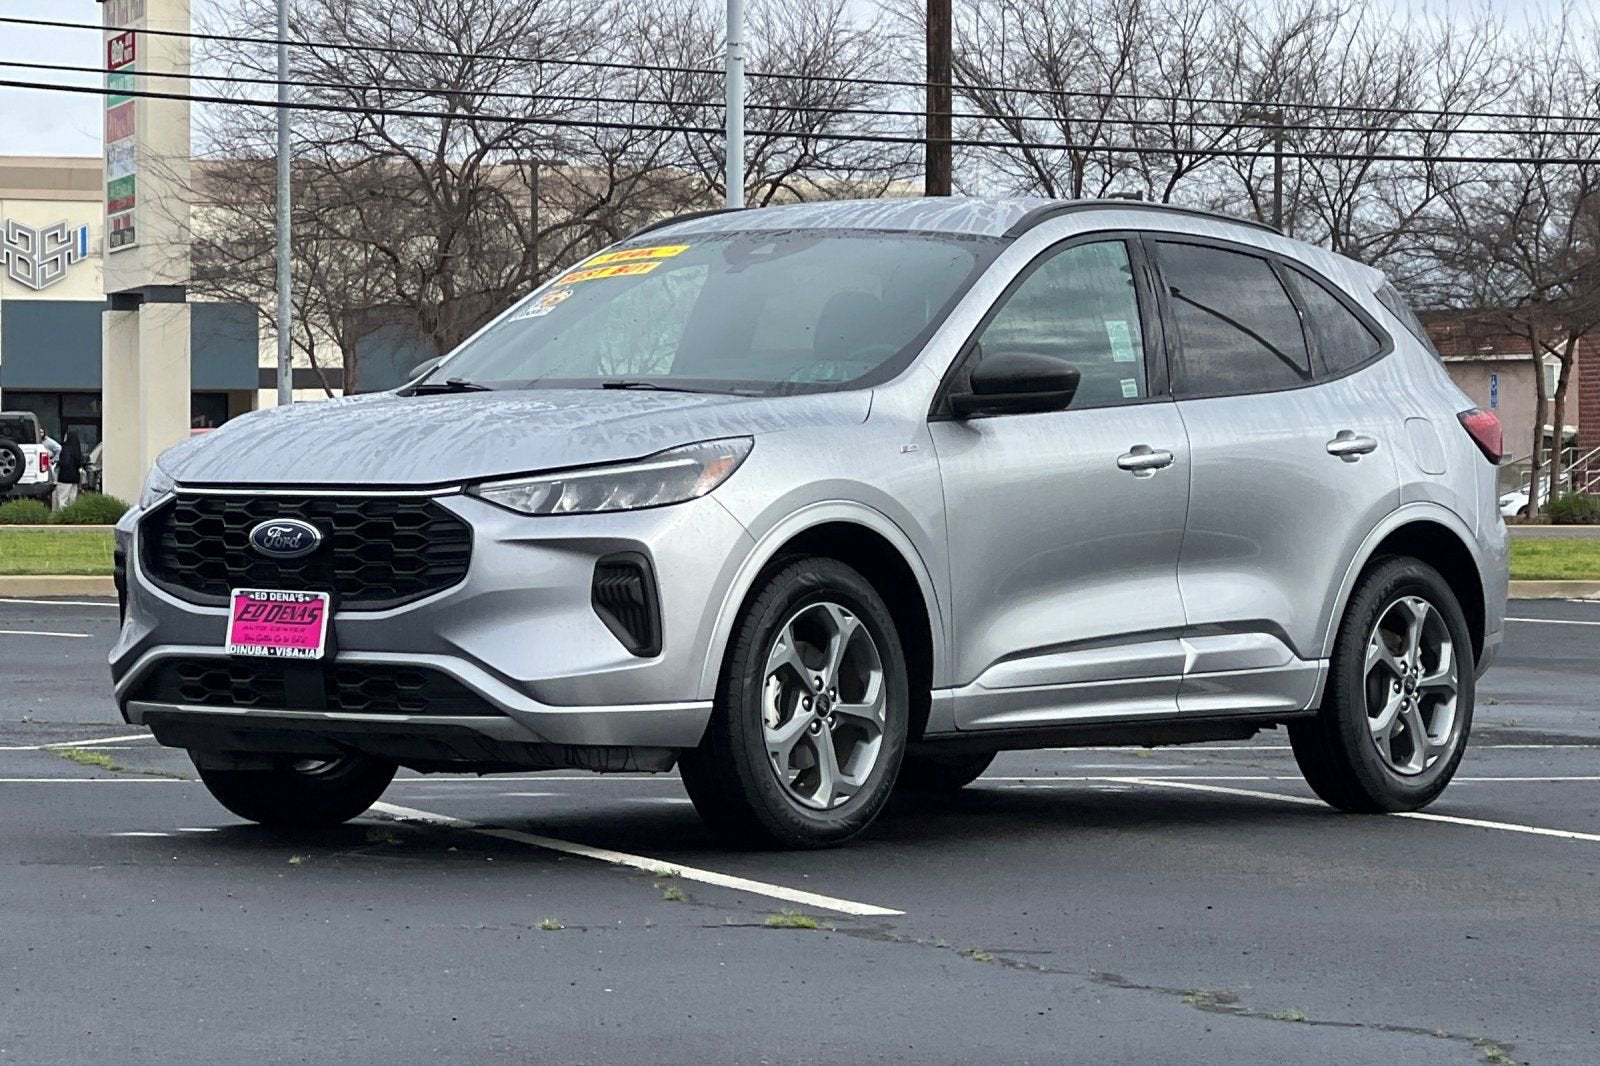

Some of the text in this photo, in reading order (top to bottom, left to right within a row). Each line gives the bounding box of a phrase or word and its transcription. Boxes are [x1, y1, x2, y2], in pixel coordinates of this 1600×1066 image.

[263, 526, 303, 549] Ford
[255, 592, 305, 603] ED DENA'S
[230, 645, 317, 659] DINUBA VISALIA
